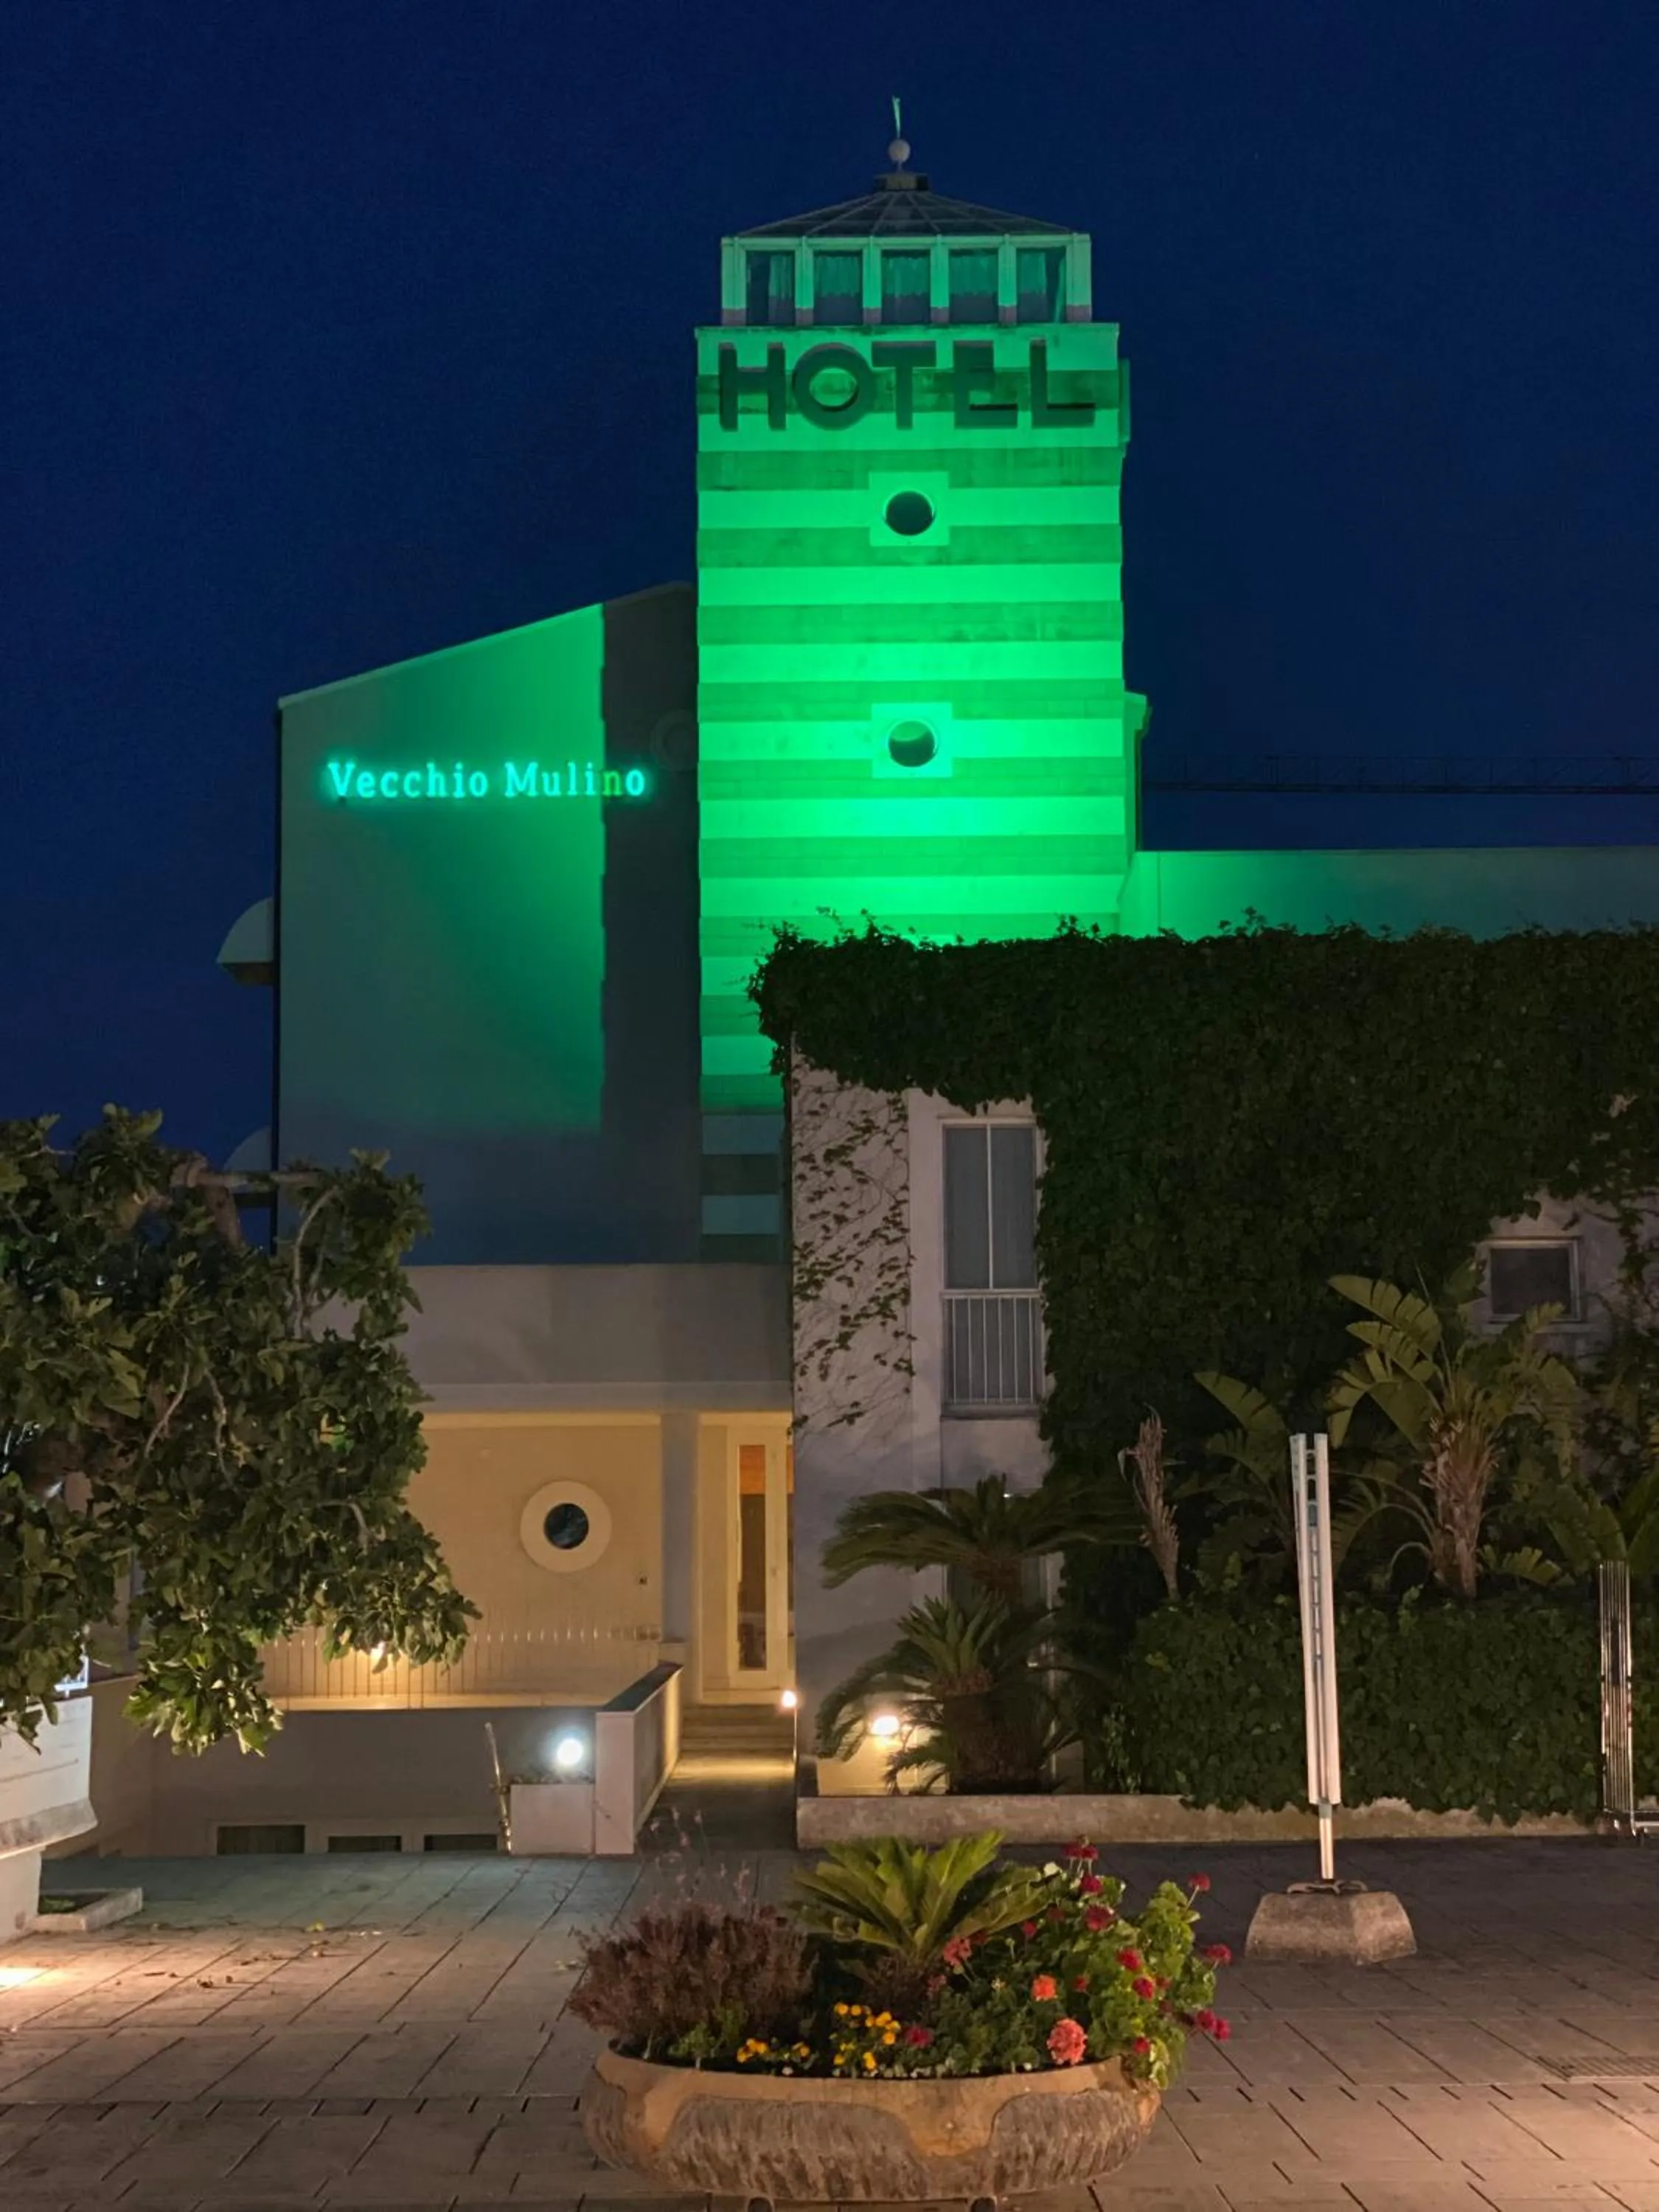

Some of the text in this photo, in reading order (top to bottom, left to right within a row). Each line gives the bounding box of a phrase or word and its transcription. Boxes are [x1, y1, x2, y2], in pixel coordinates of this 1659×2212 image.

[719, 340, 1096, 431] HOTEL
[327, 762, 645, 799] Vecchio Mulino
